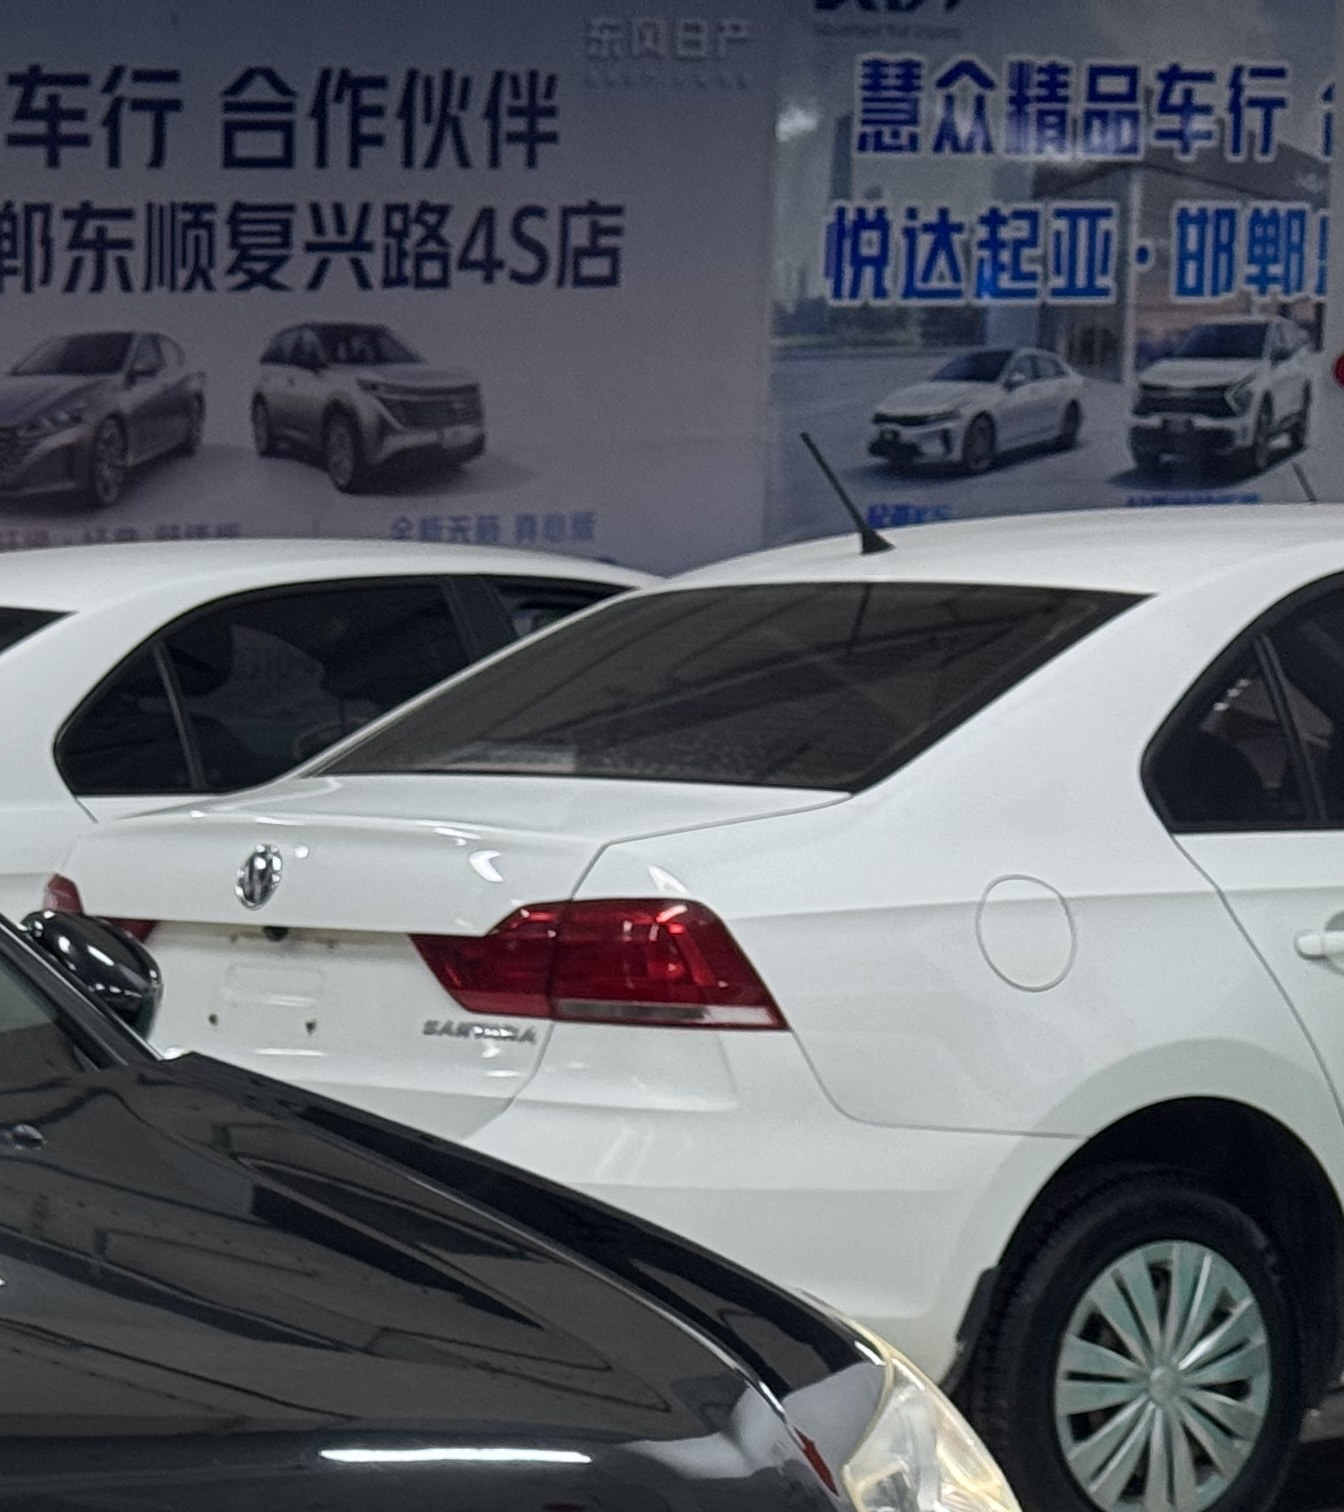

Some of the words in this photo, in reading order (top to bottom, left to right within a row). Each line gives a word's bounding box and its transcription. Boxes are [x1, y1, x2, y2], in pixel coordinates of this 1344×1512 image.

[586, 17, 752, 57] 东风日产
[219, 66, 561, 170] 合作伙伴
[857, 59, 1289, 157] 慧众精品车行
